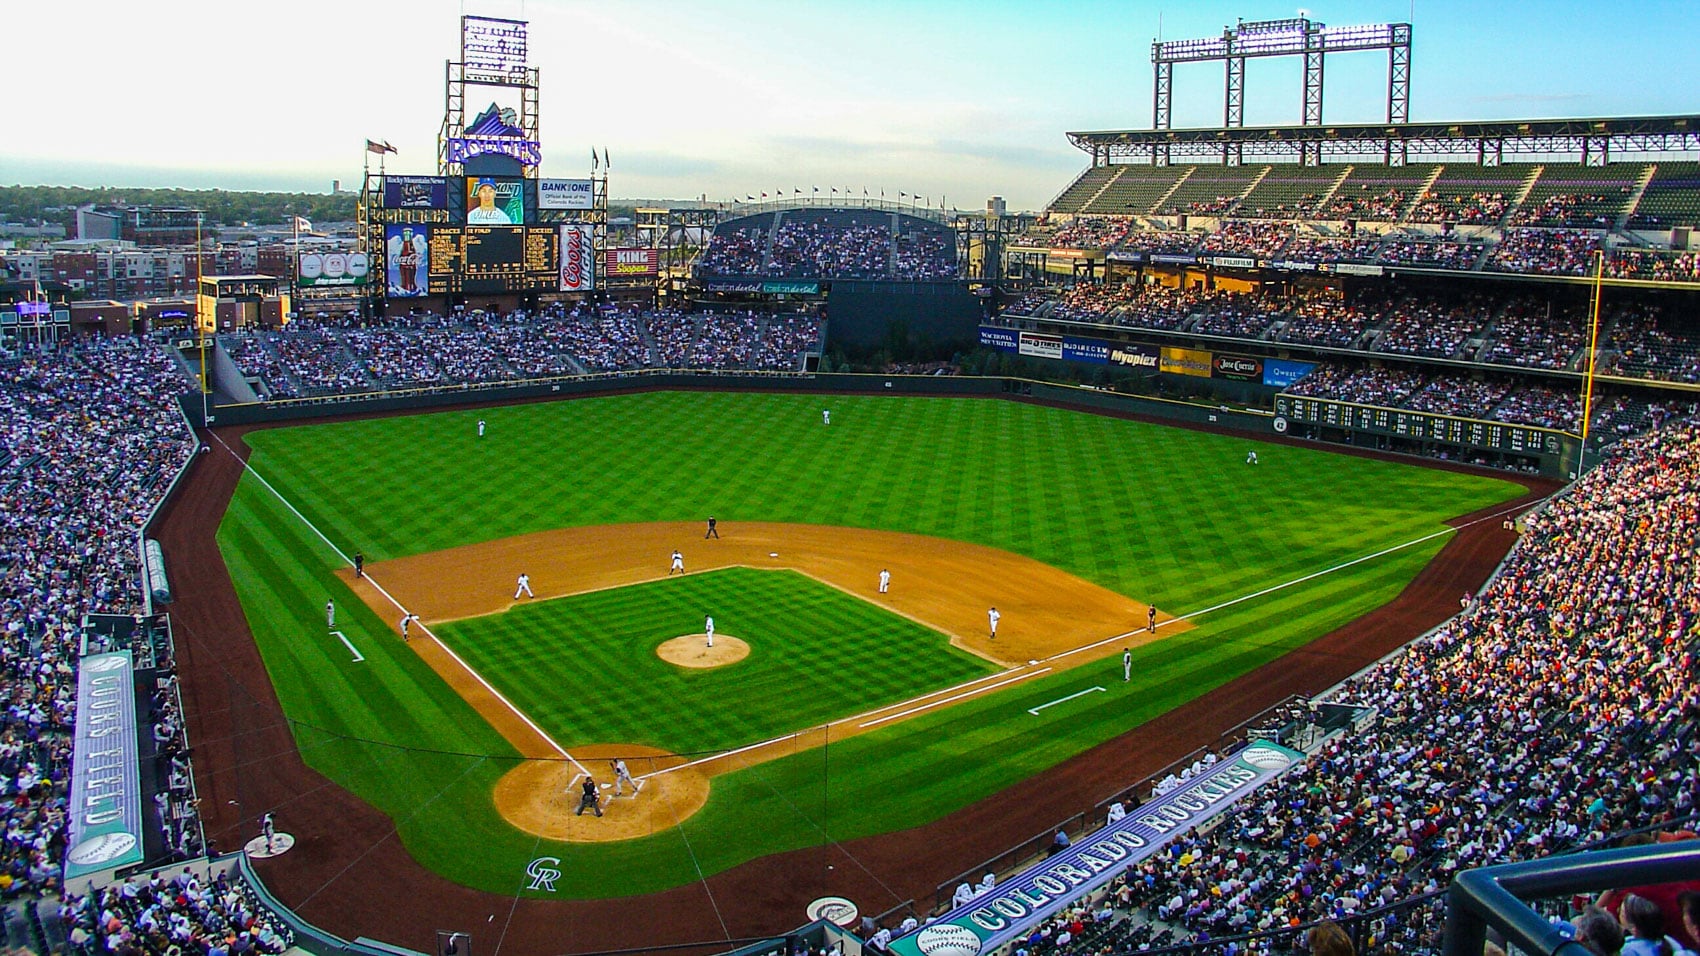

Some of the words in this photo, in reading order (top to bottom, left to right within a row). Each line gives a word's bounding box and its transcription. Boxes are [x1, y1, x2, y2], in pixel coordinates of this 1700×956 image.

[448, 138, 542, 166] ROCKIES
[386, 176, 402, 185] Rocky
[542, 183, 566, 191] BANK
[572, 184, 590, 192] ONE
[392, 253, 422, 266] Coca-Cola
[562, 229, 582, 289] Coors
[580, 231, 595, 288] LIGHT
[616, 251, 649, 263] KING
[616, 264, 649, 275] Soopers
[735, 283, 761, 292] dental
[790, 284, 818, 294] dental
[981, 332, 1012, 341] WACHOVIA
[980, 339, 1017, 348] SECURITIES
[1111, 350, 1157, 367] Myoplex
[1220, 360, 1234, 369] Jose
[1234, 361, 1255, 371] Cuervo
[1274, 368, 1296, 377] Qwest
[90, 675, 123, 738] COORS
[86, 746, 124, 825] FIELD
[968, 830, 1147, 932] COLORADO
[1136, 764, 1259, 834] ROCKIES
[526, 857, 561, 892] CR
